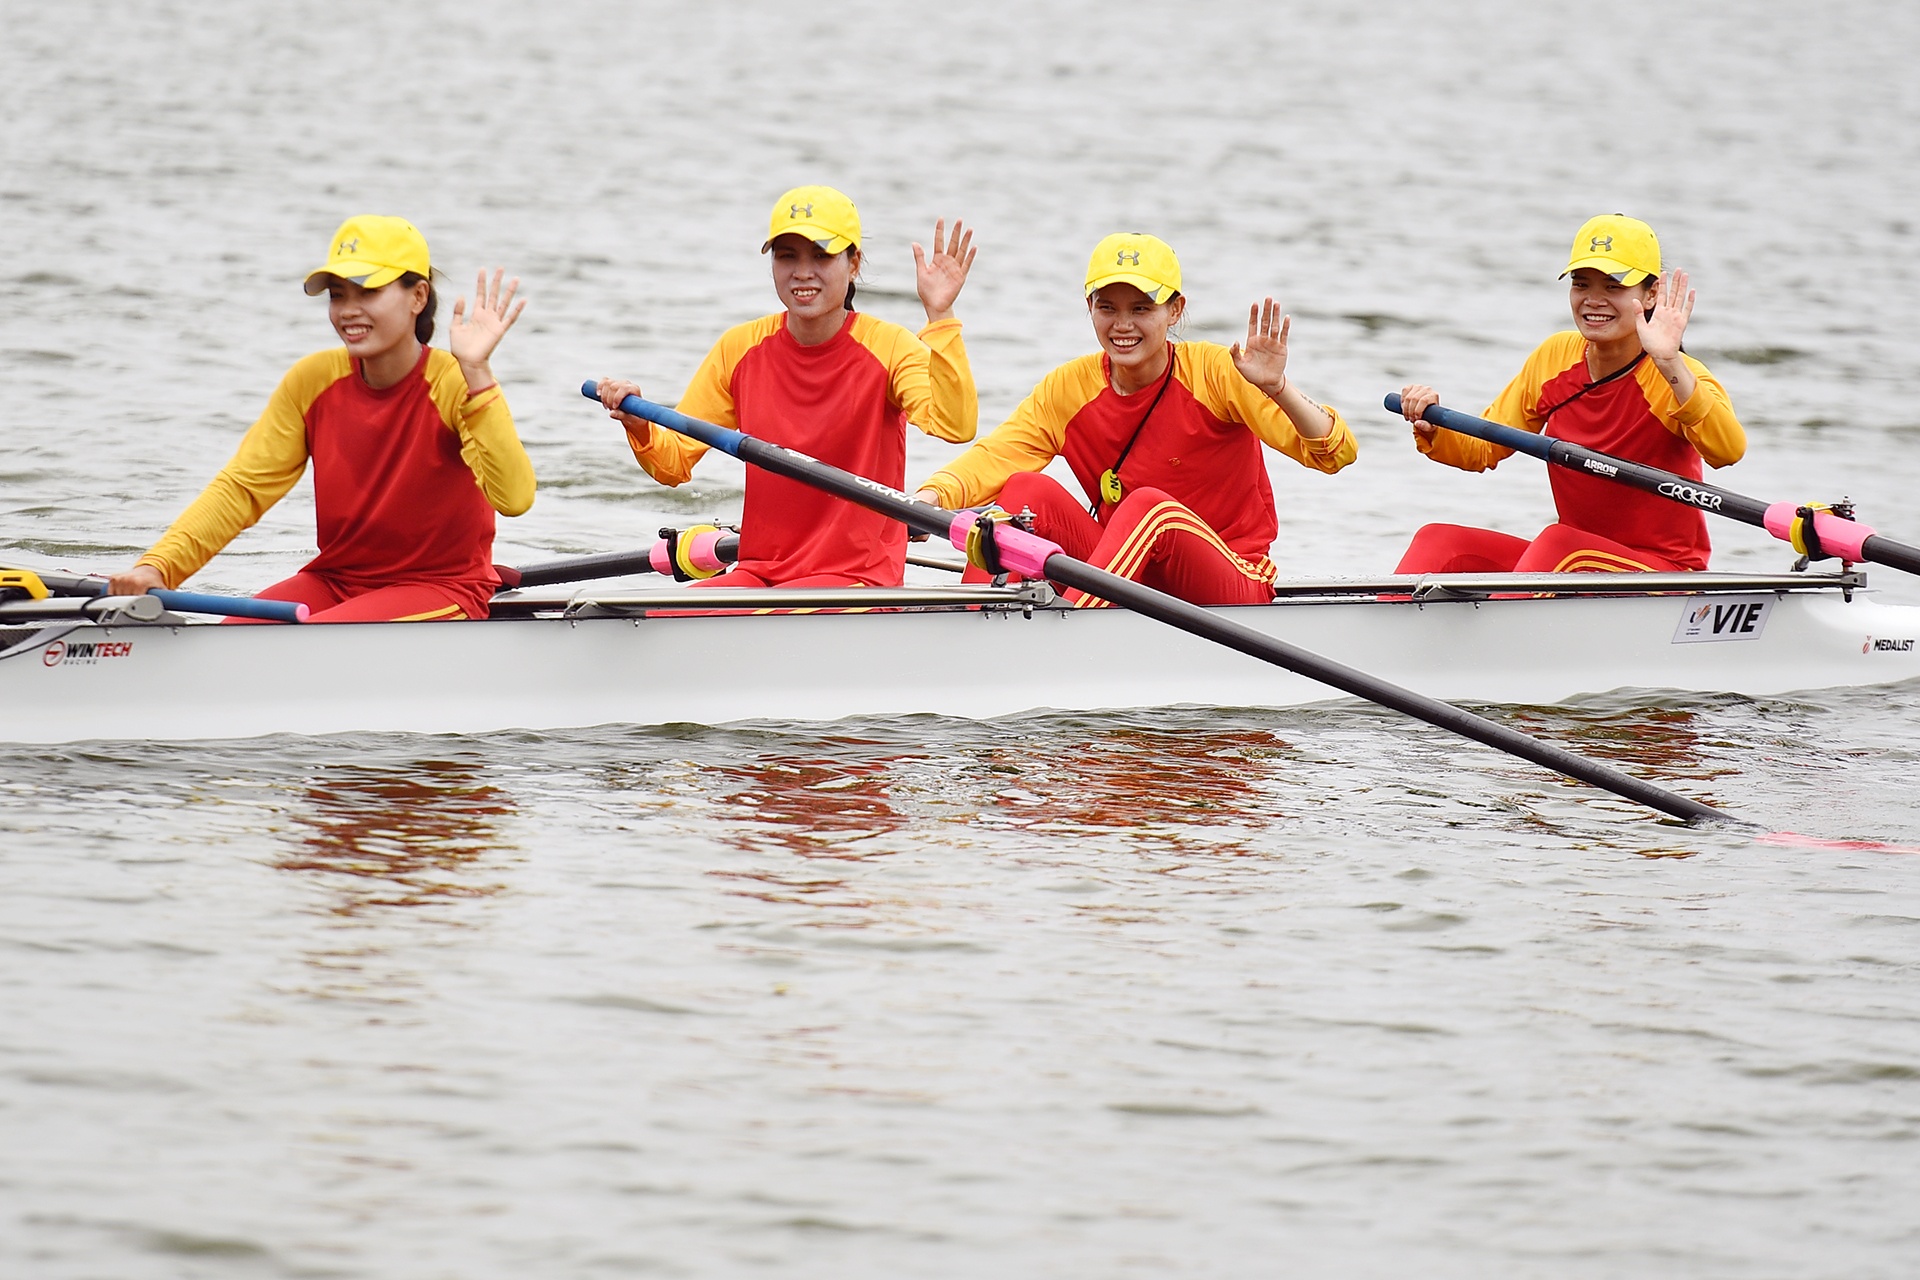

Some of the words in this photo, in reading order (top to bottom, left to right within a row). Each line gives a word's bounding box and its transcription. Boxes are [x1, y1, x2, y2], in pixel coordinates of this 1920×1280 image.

[1584, 458, 1618, 476] ARROW
[1657, 482, 1722, 510] CROKER
[1713, 603, 1764, 634] VIE
[66, 642, 133, 658] WINTECH
[1873, 639, 1915, 651] MEDALIST
